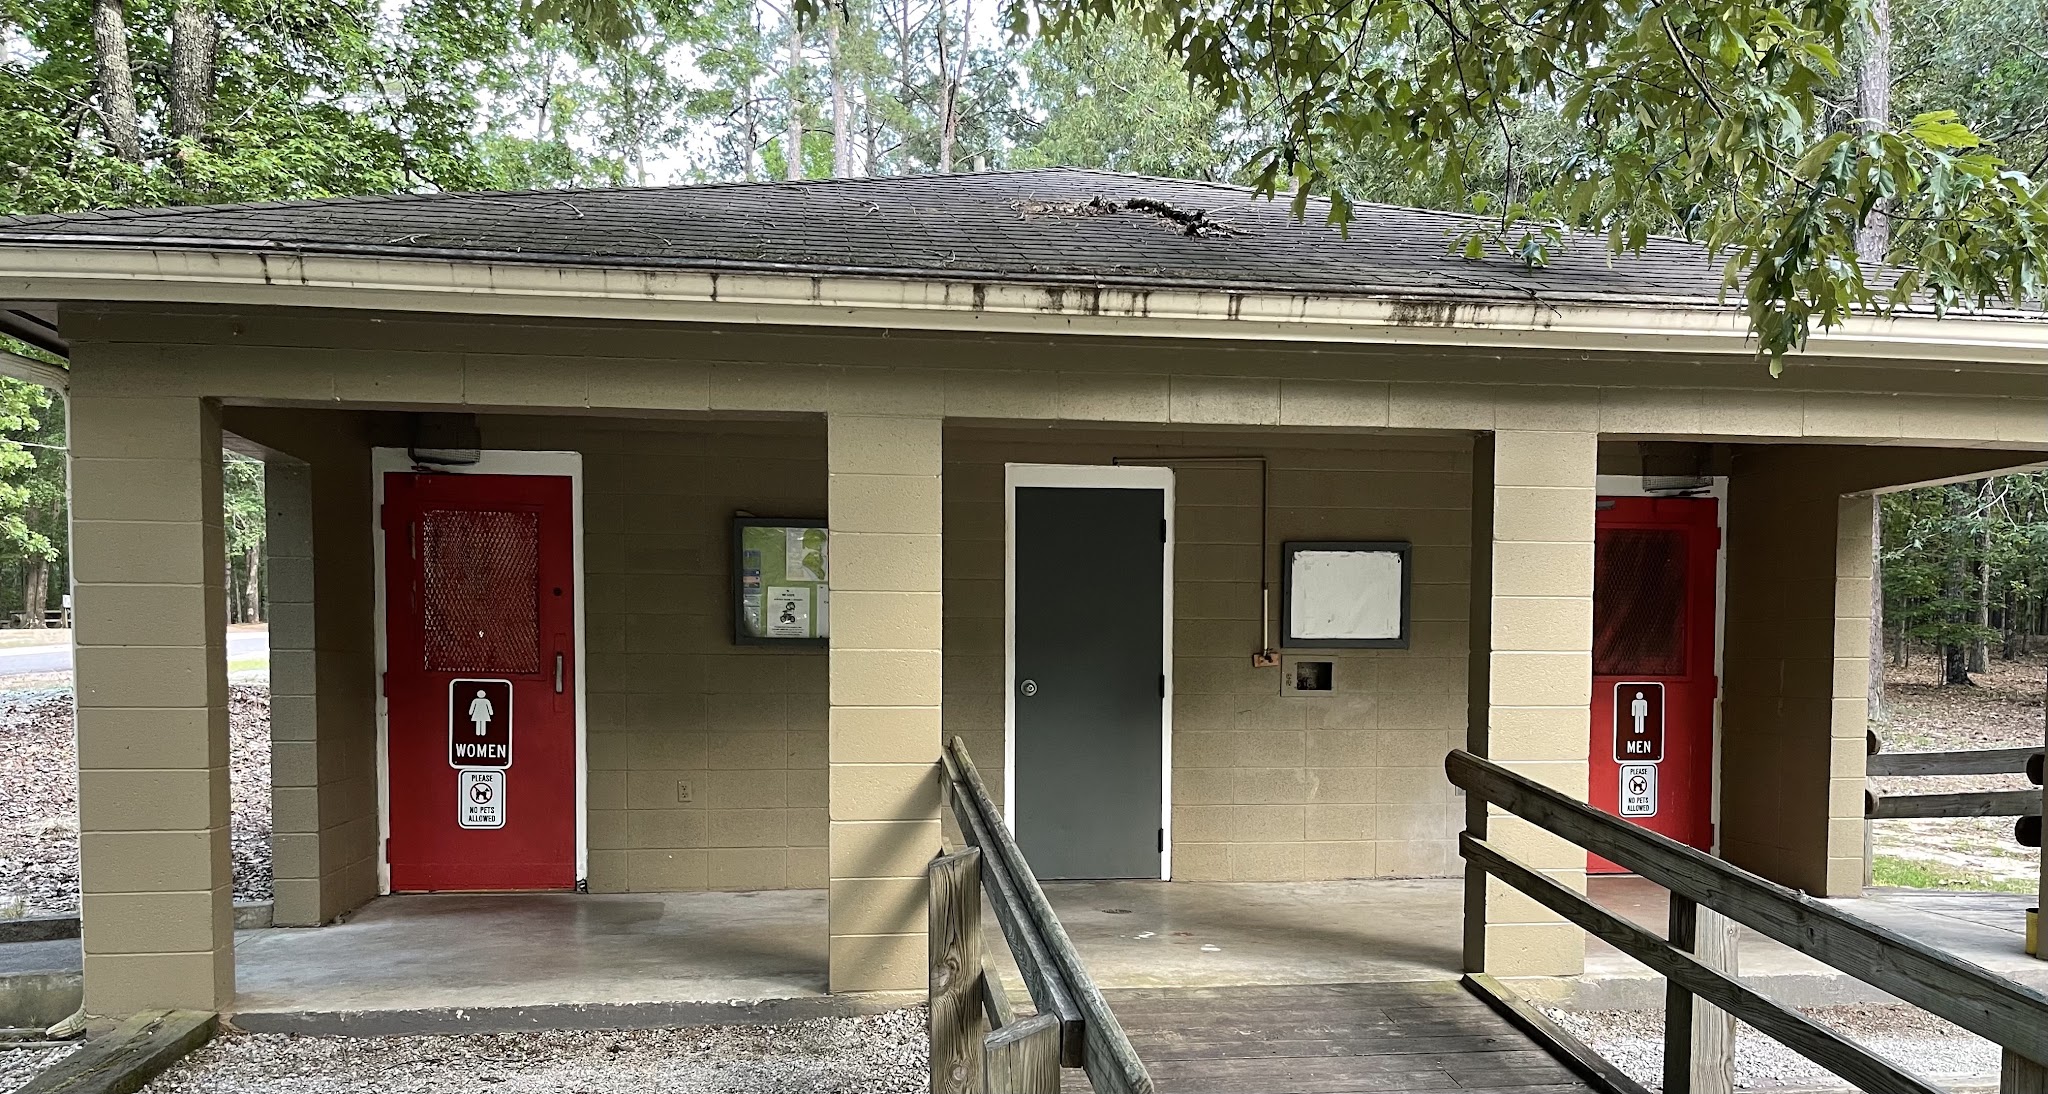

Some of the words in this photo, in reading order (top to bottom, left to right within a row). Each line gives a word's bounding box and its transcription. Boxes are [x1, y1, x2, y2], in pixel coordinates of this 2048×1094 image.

[456, 743, 506, 758] WOMEN
[1627, 740, 1651, 754] MEN
[471, 774, 493, 782] PLEASE
[469, 806, 478, 814] NO
[480, 806, 495, 814] PETS
[1627, 804, 1650, 812] ALLOWED
[468, 814, 496, 822] ALLOWED
